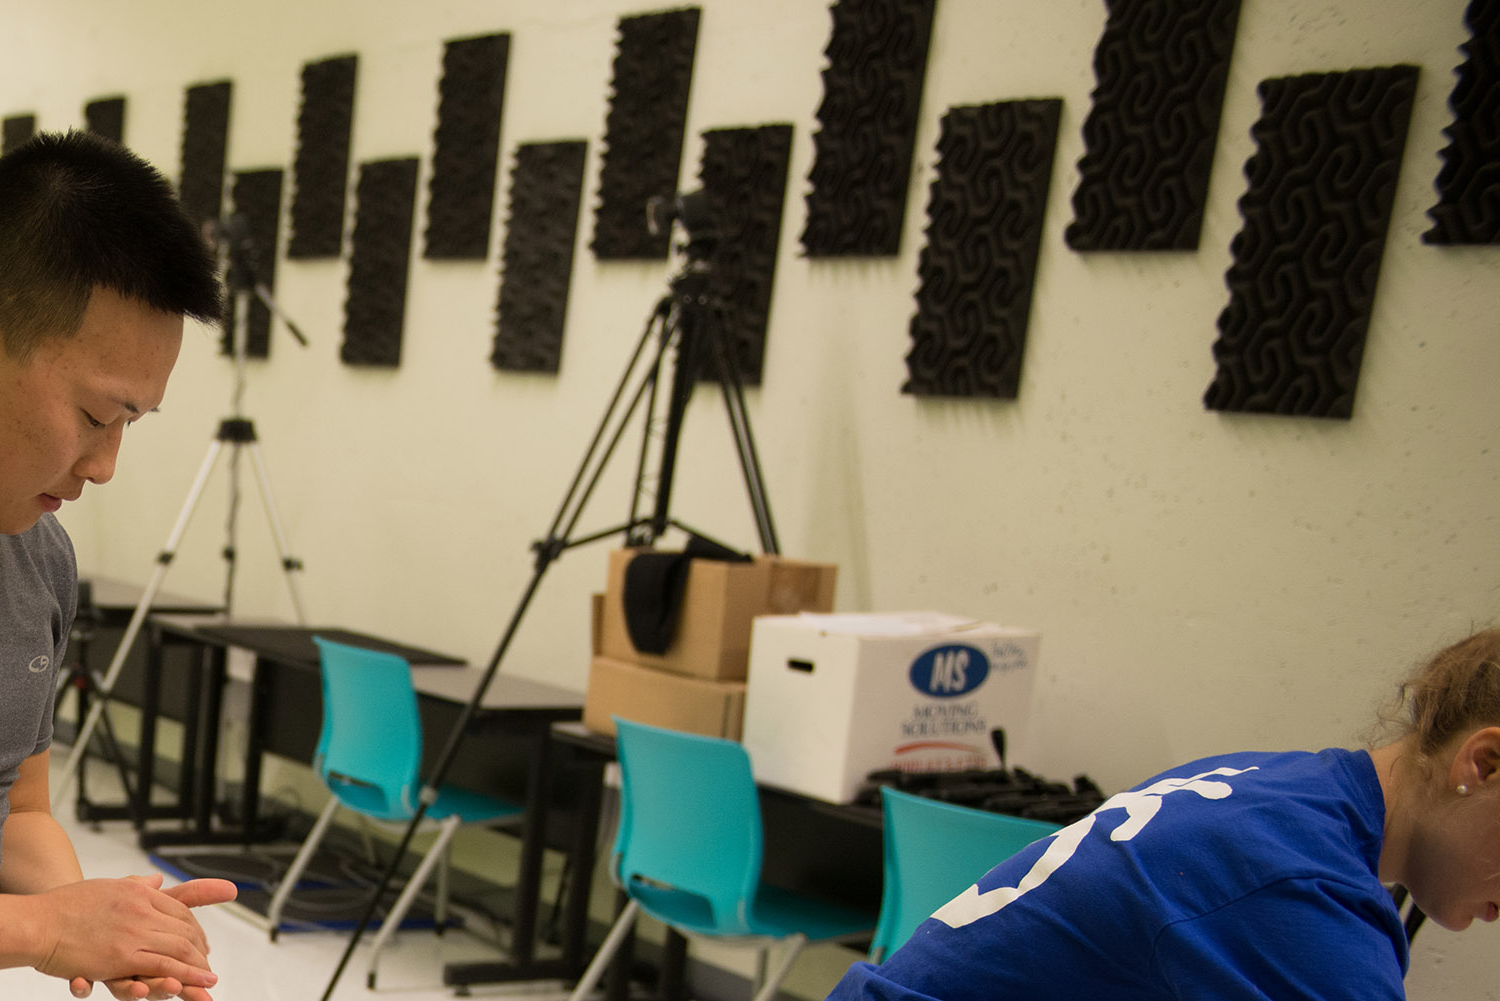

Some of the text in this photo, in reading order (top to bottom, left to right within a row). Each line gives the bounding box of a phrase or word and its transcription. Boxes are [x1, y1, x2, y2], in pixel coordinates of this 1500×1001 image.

[929, 649, 970, 694] MS
[912, 702, 979, 720] MOVING
[901, 719, 987, 737] SOLUTIONS
